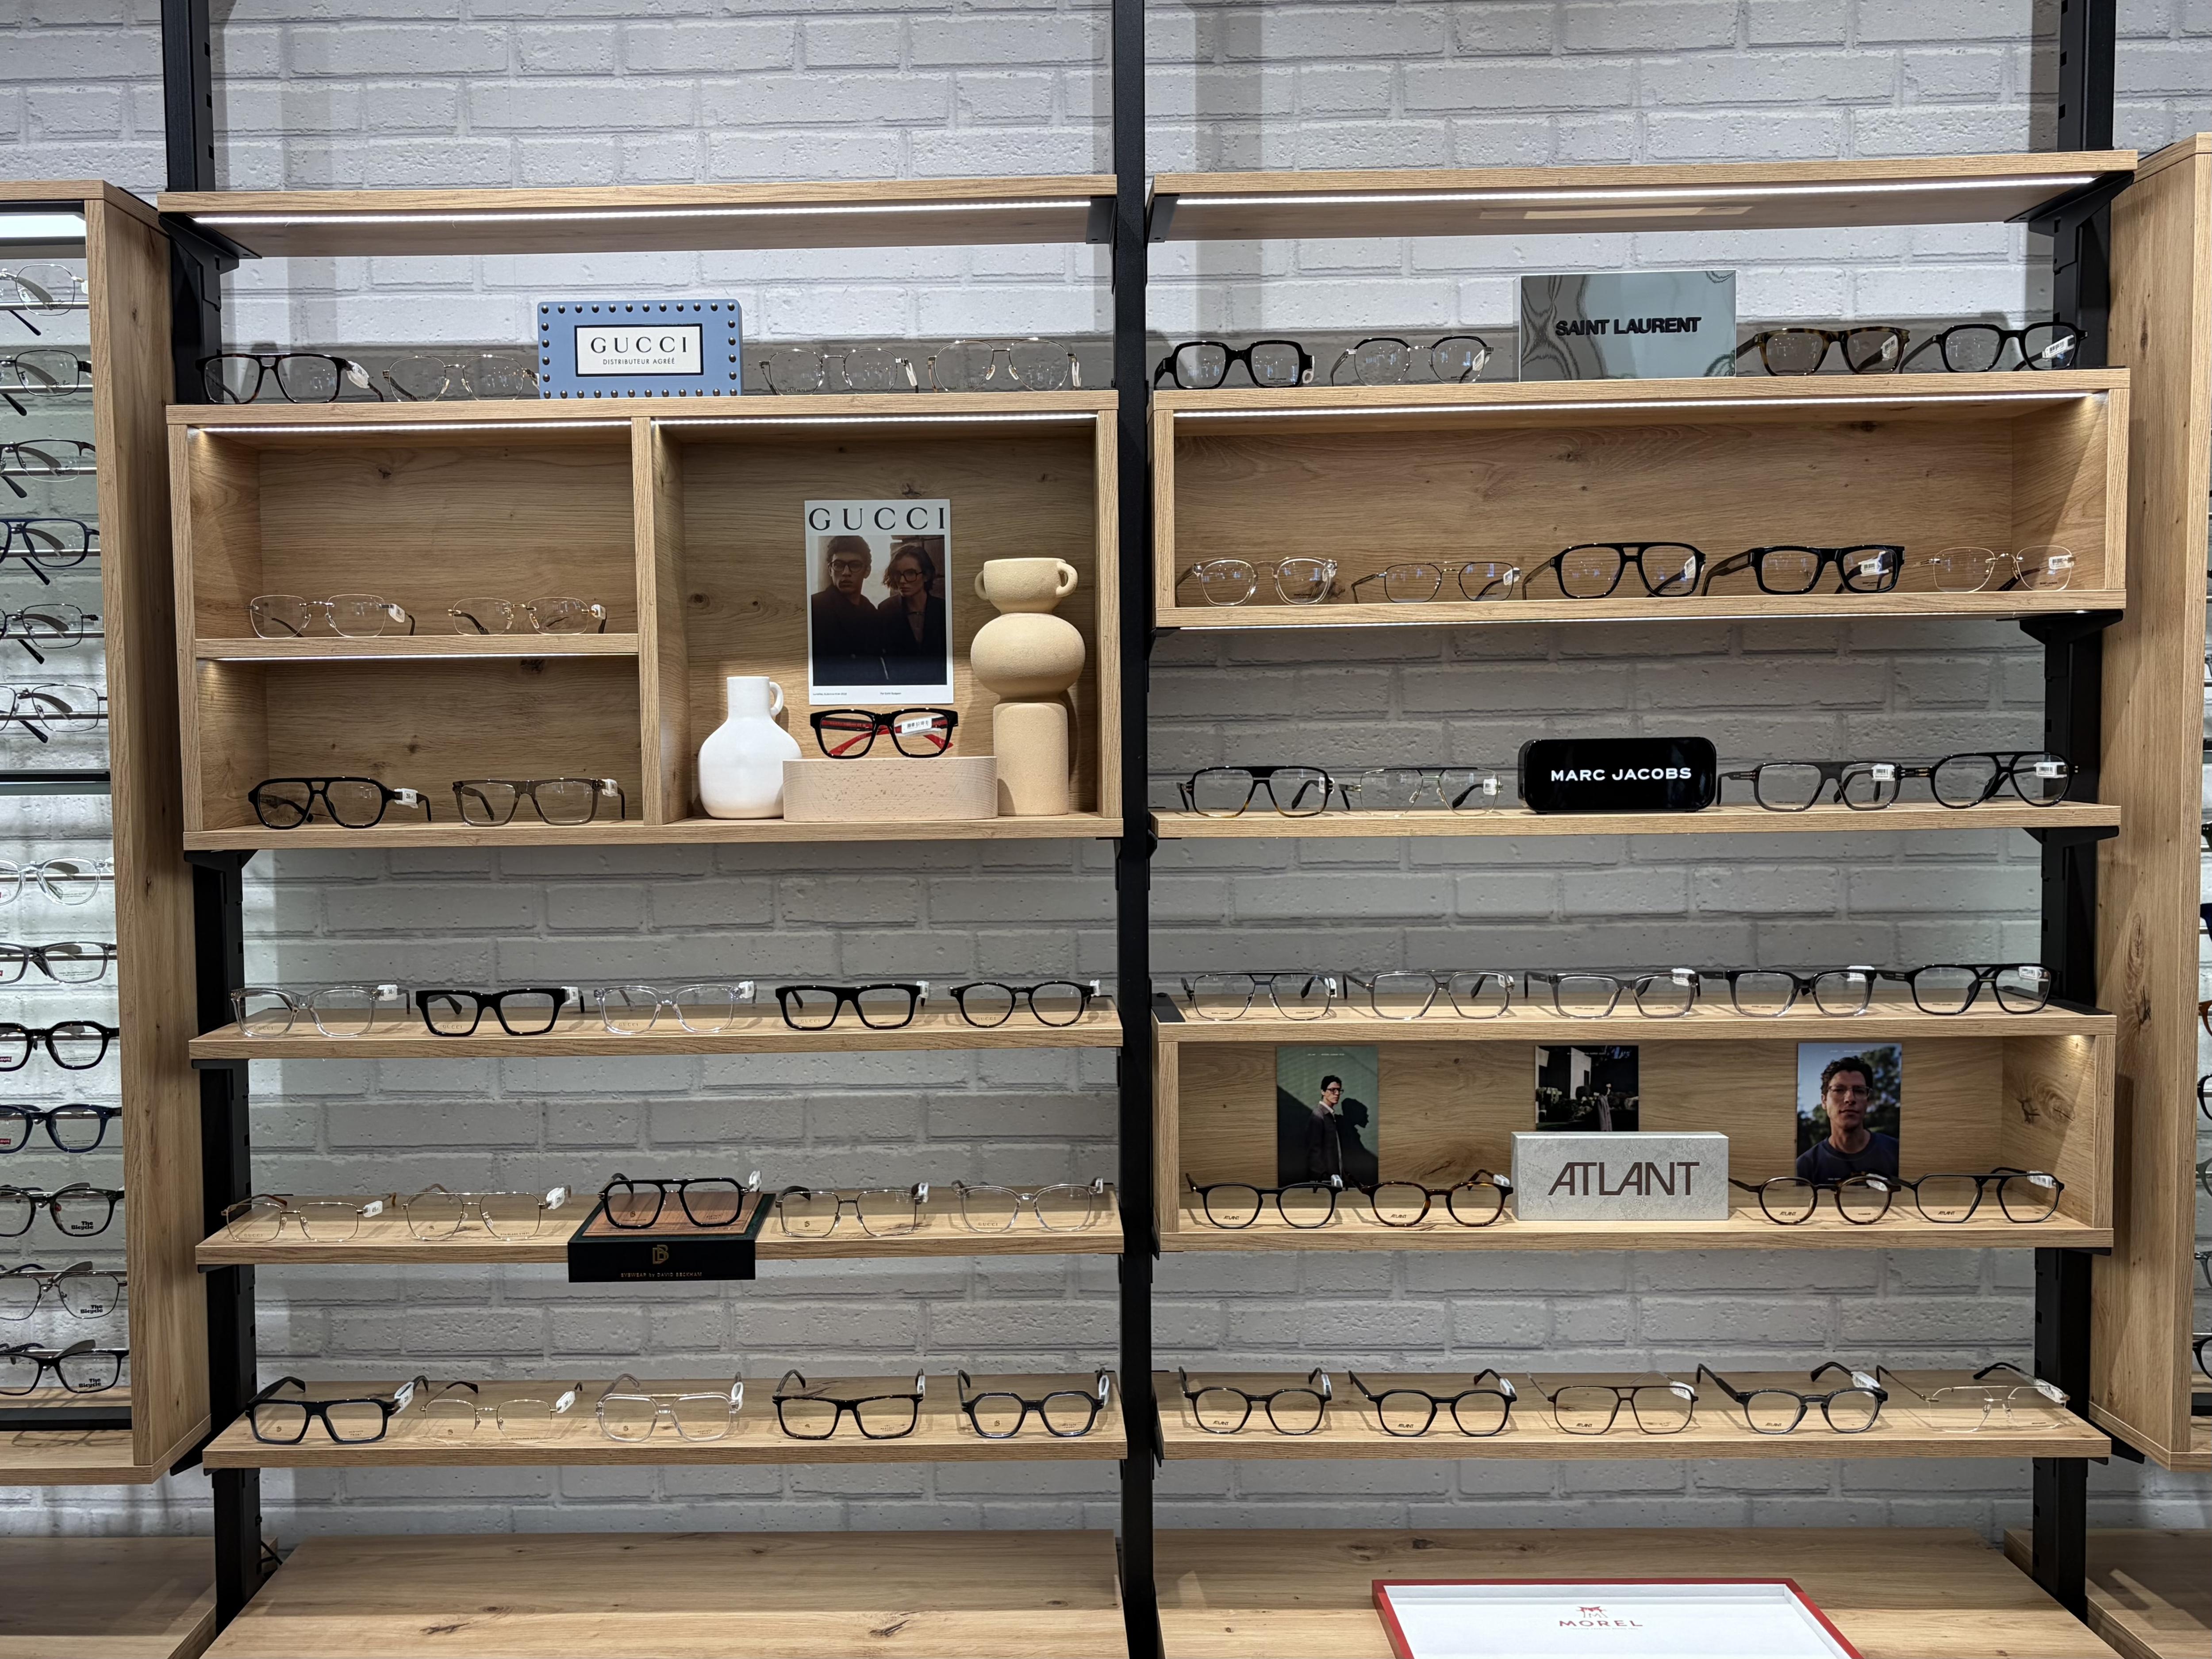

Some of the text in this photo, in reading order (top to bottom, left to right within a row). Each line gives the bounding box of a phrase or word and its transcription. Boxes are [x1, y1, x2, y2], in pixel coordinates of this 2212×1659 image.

[1555, 317, 1701, 335] SAINT LAURENT
[591, 336, 687, 353] GUCCI
[808, 507, 945, 531] GUCCI
[1551, 767, 1692, 782] MARC JACOBS
[1548, 1162, 1700, 1196] ATLANT
